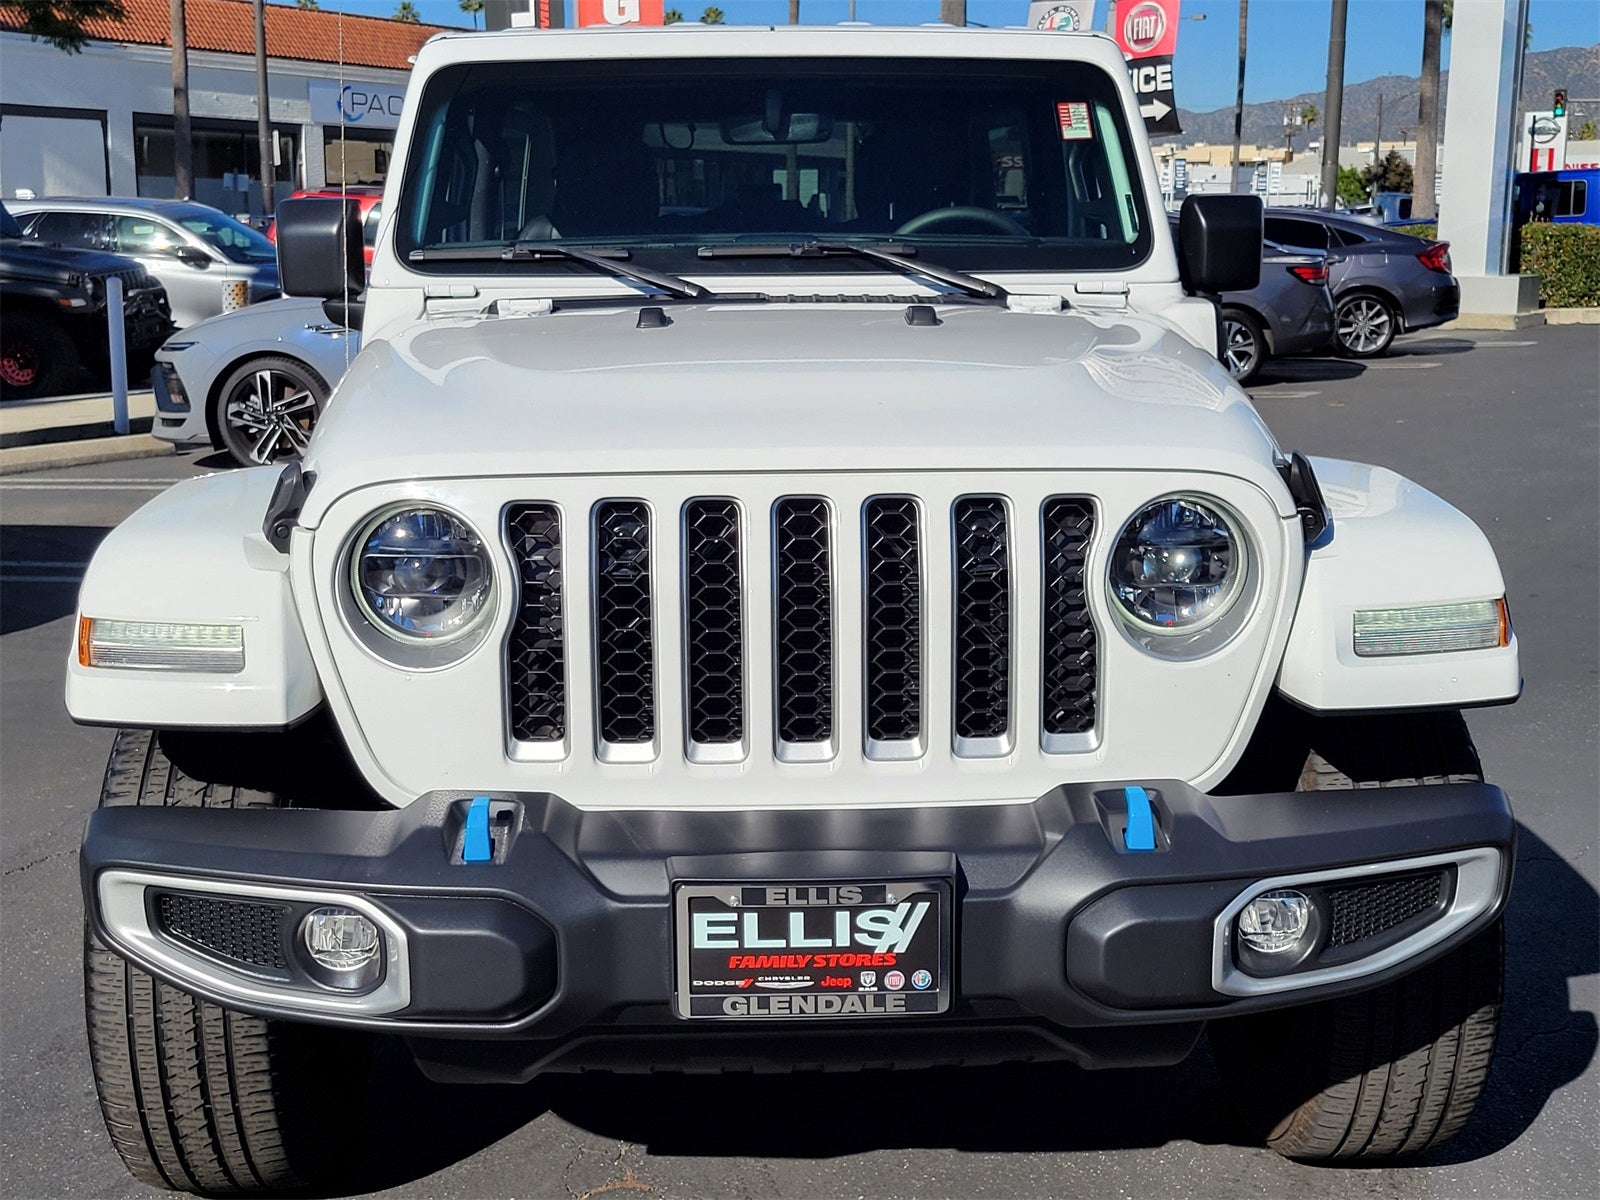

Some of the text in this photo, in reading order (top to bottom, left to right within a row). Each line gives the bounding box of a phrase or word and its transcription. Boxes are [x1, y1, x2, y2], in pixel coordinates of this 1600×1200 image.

[1133, 15, 1158, 41] FIAT
[1129, 64, 1173, 94] ICE
[765, 886, 863, 905] ELLIS
[693, 909, 904, 949] ELLIS
[728, 953, 897, 969] FAMILY STORES
[820, 975, 853, 988] Jeep
[722, 994, 907, 1016] GLENDALE
